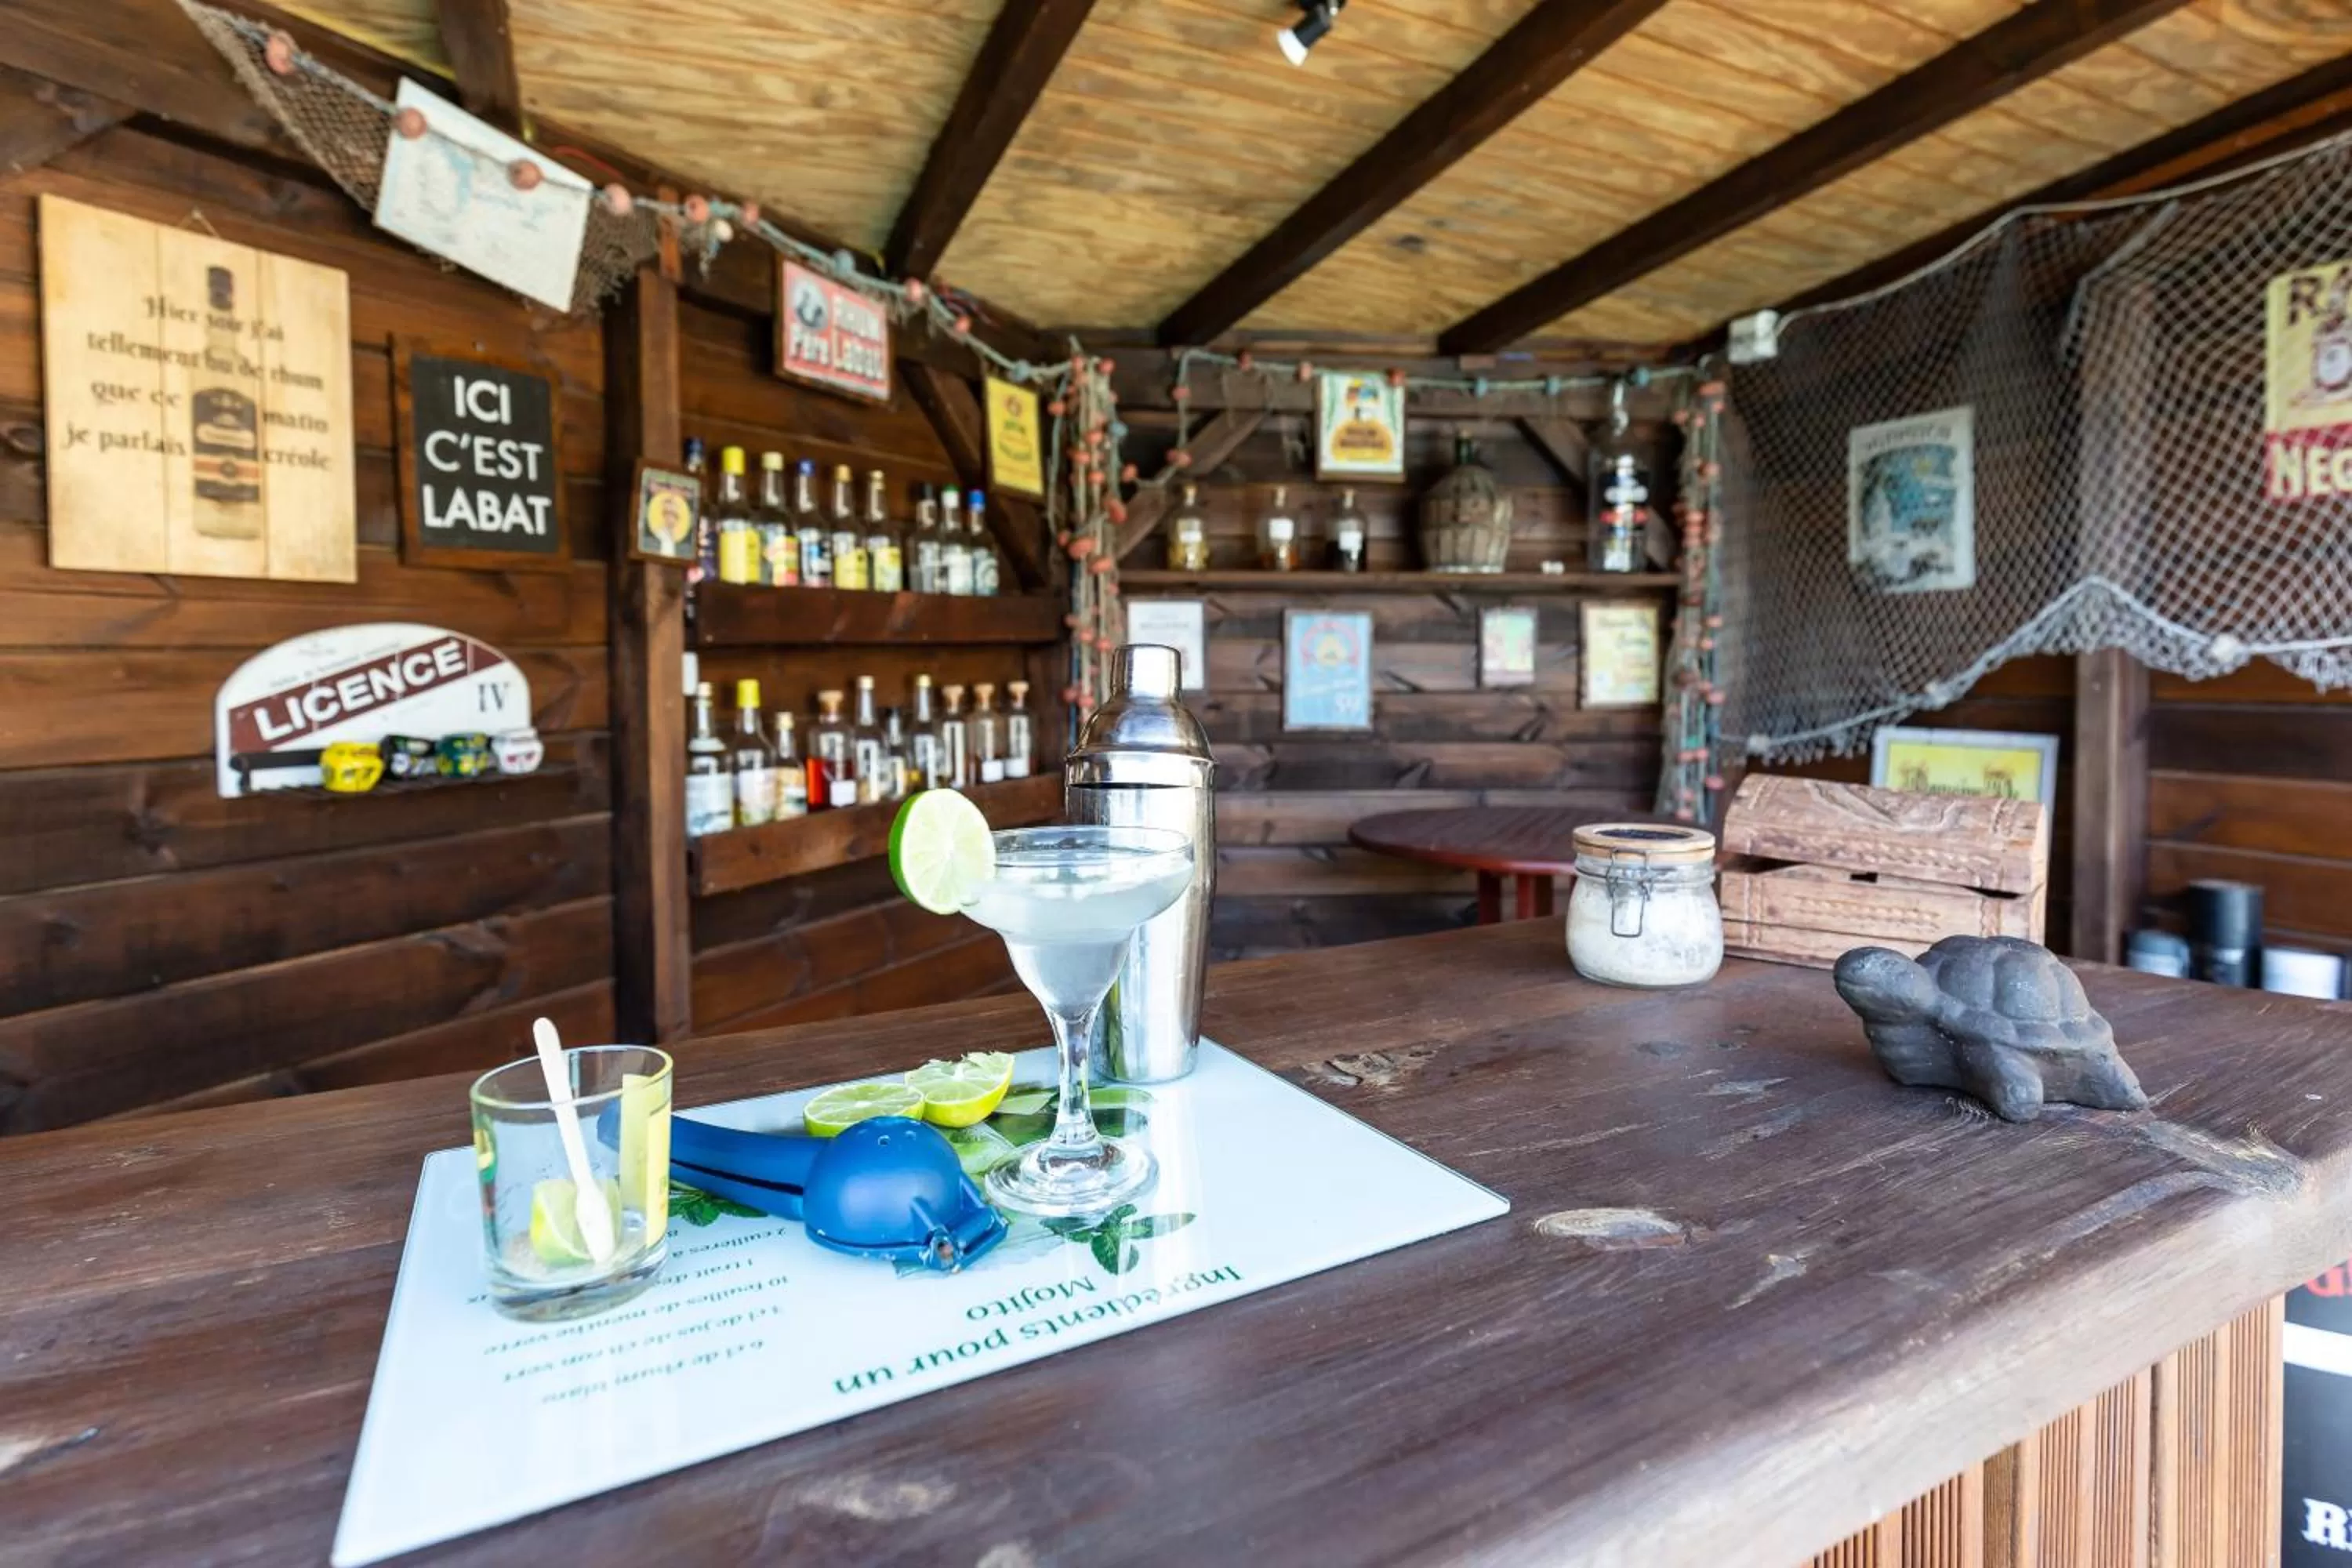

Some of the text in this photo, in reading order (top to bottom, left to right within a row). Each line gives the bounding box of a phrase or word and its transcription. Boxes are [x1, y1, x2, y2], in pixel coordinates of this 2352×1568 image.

[141, 294, 198, 322] Hier
[87, 329, 199, 369] tellement
[238, 357, 264, 379] de
[270, 363, 324, 390] rhum
[90, 381, 329, 434] que ce matin
[454, 375, 511, 425] ICI
[60, 419, 90, 450] je
[98, 430, 187, 456] parlais
[423, 430, 544, 481] C'EST
[421, 483, 552, 535] LABAT
[252, 641, 467, 742] LICENCE
[477, 682, 510, 713] IV
[966, 1275, 1098, 1321] Mojito
[906, 1328, 1014, 1374] pour
[833, 1367, 893, 1396] un
[2302, 1497, 2352, 1552] R
